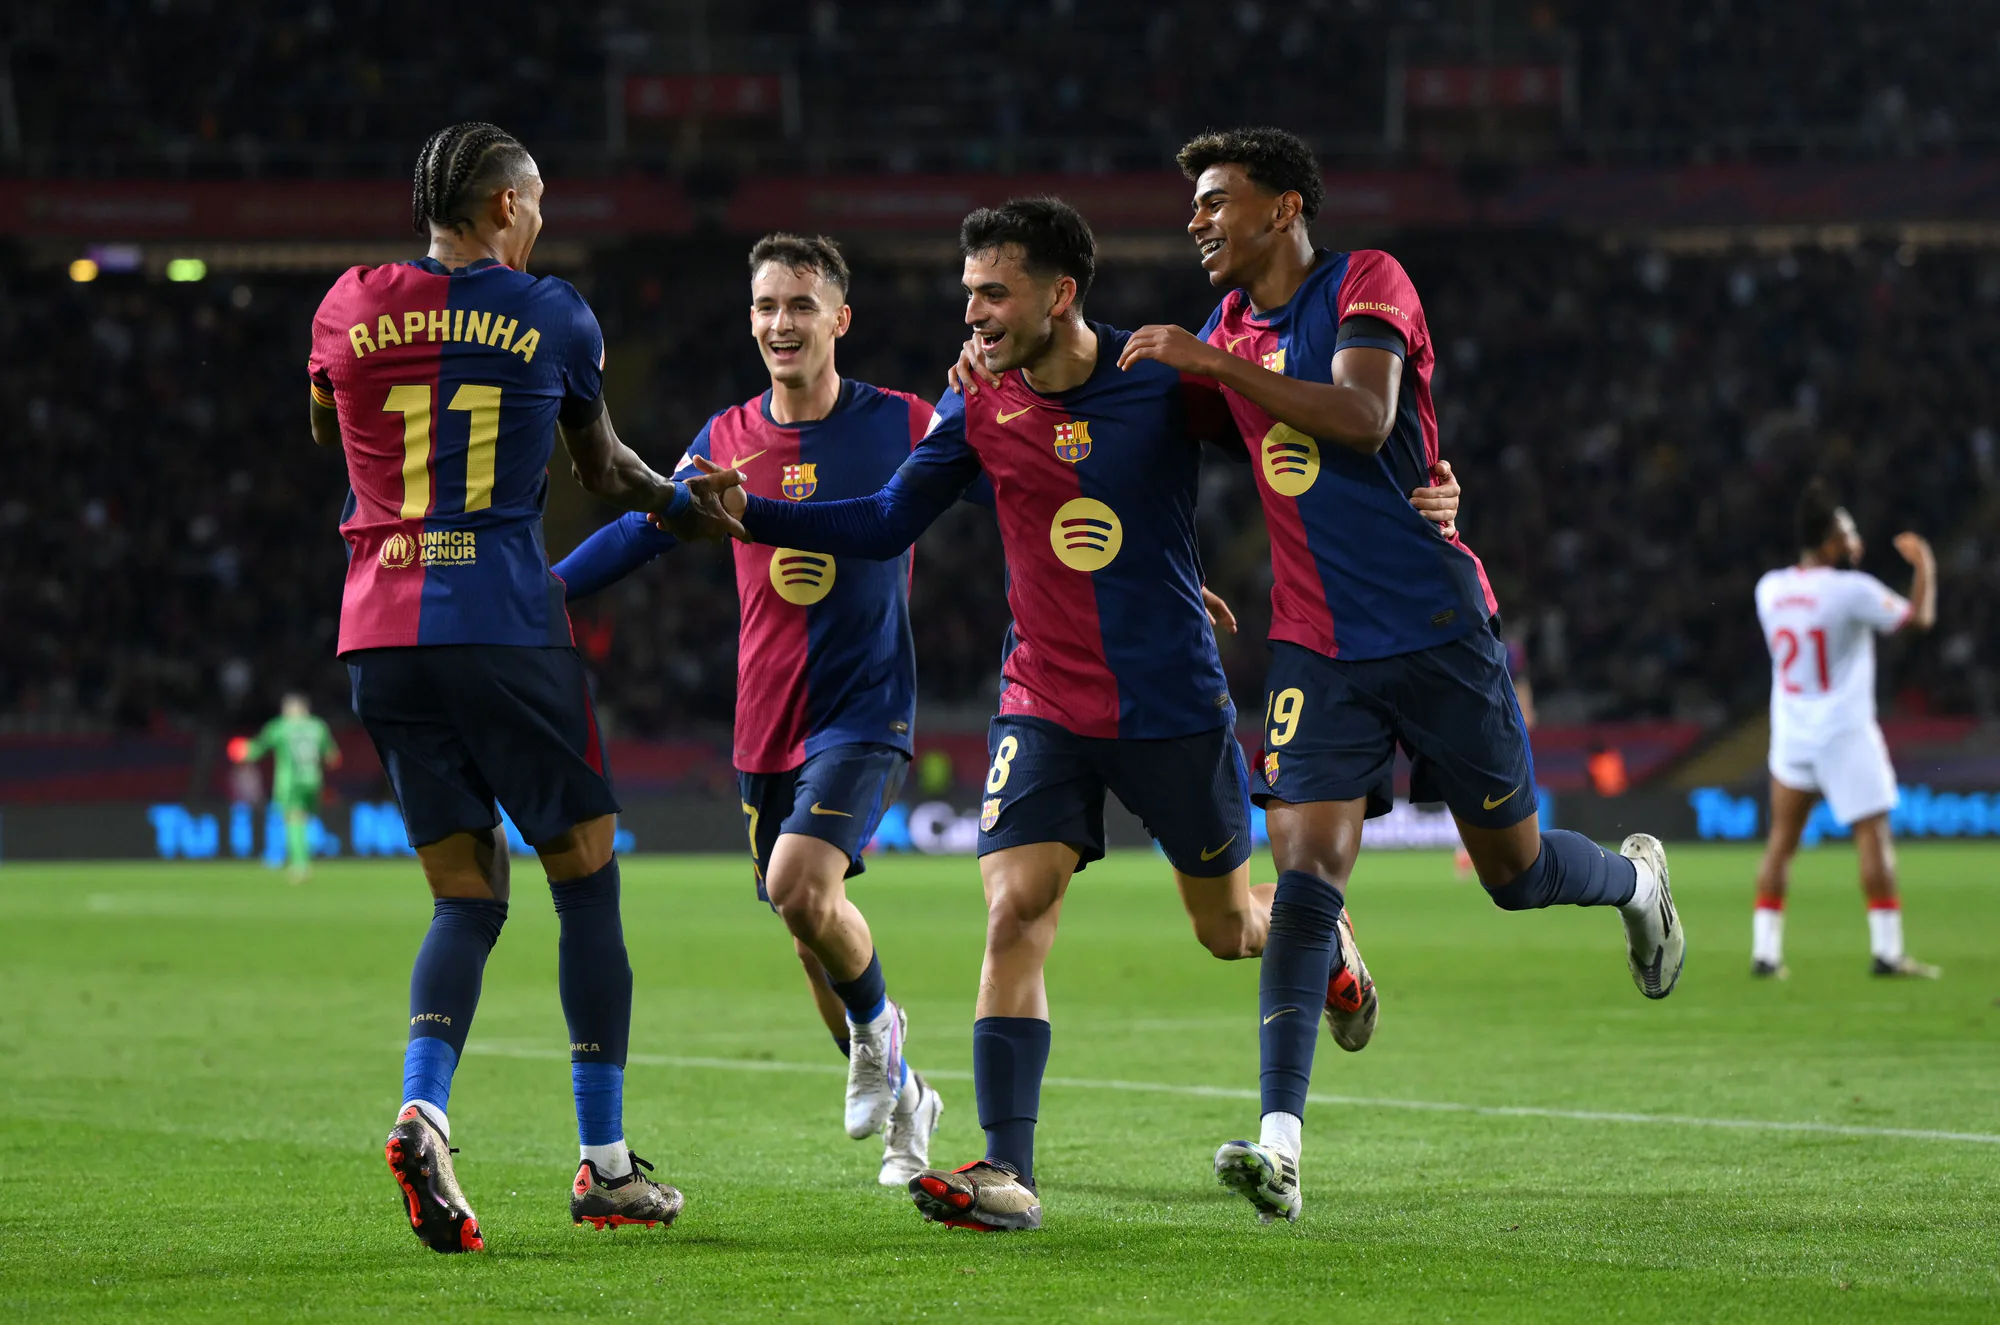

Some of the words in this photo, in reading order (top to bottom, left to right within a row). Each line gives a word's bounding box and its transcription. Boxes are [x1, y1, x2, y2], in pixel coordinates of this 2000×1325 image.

[1345, 302, 1399, 316] MBILIGHT
[1401, 312, 1409, 321] tv
[349, 309, 541, 363] RAPHINHA
[382, 384, 502, 520] 11
[418, 532, 476, 546] UNHCR
[419, 546, 476, 561] ACNUR
[1773, 626, 1831, 695] 21
[987, 735, 1018, 794] 8
[569, 1042, 600, 1052] ARÇA
